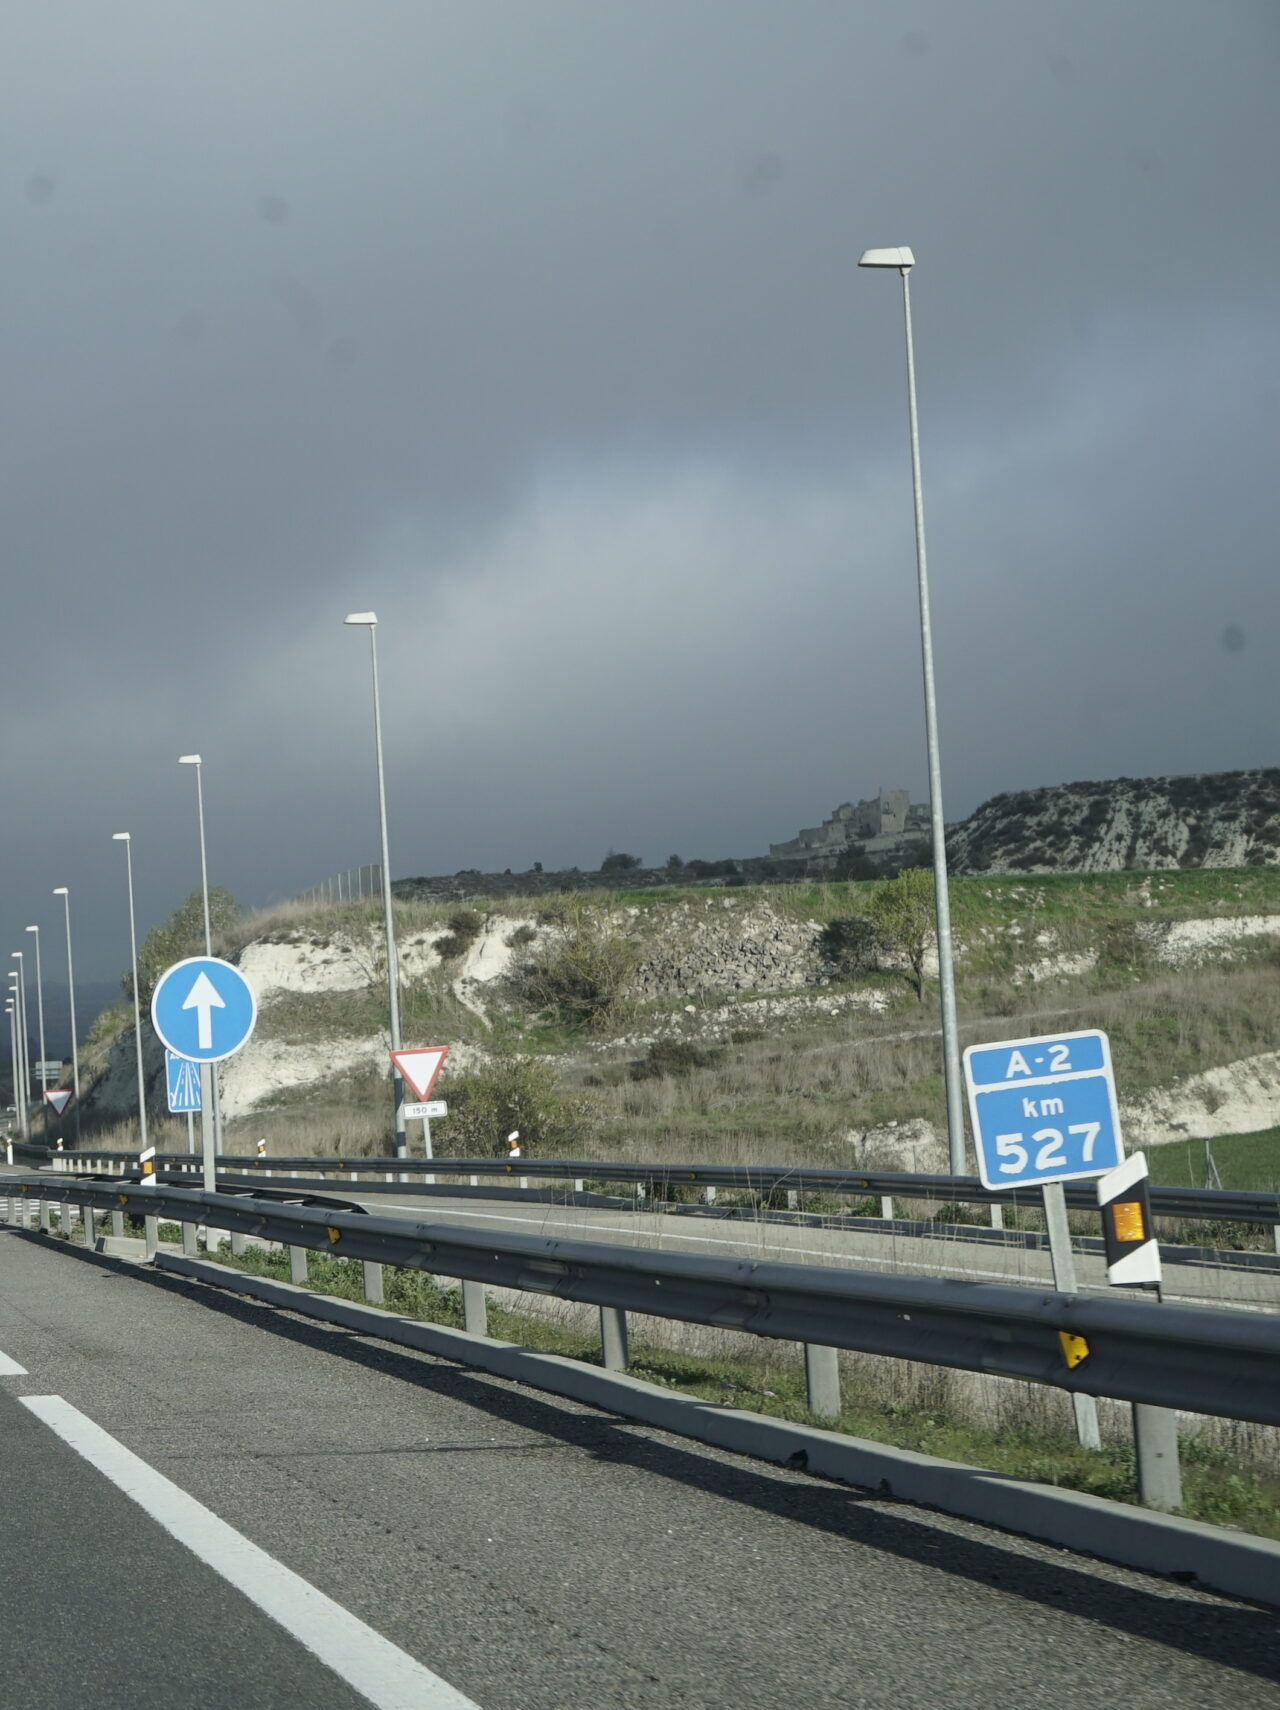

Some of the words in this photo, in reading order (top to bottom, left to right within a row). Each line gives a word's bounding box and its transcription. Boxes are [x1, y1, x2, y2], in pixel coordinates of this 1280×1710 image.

[1005, 1044, 1072, 1078] A-2
[412, 1107, 427, 1115] 150
[1022, 1097, 1064, 1118] km
[995, 1121, 1101, 1174] 527
